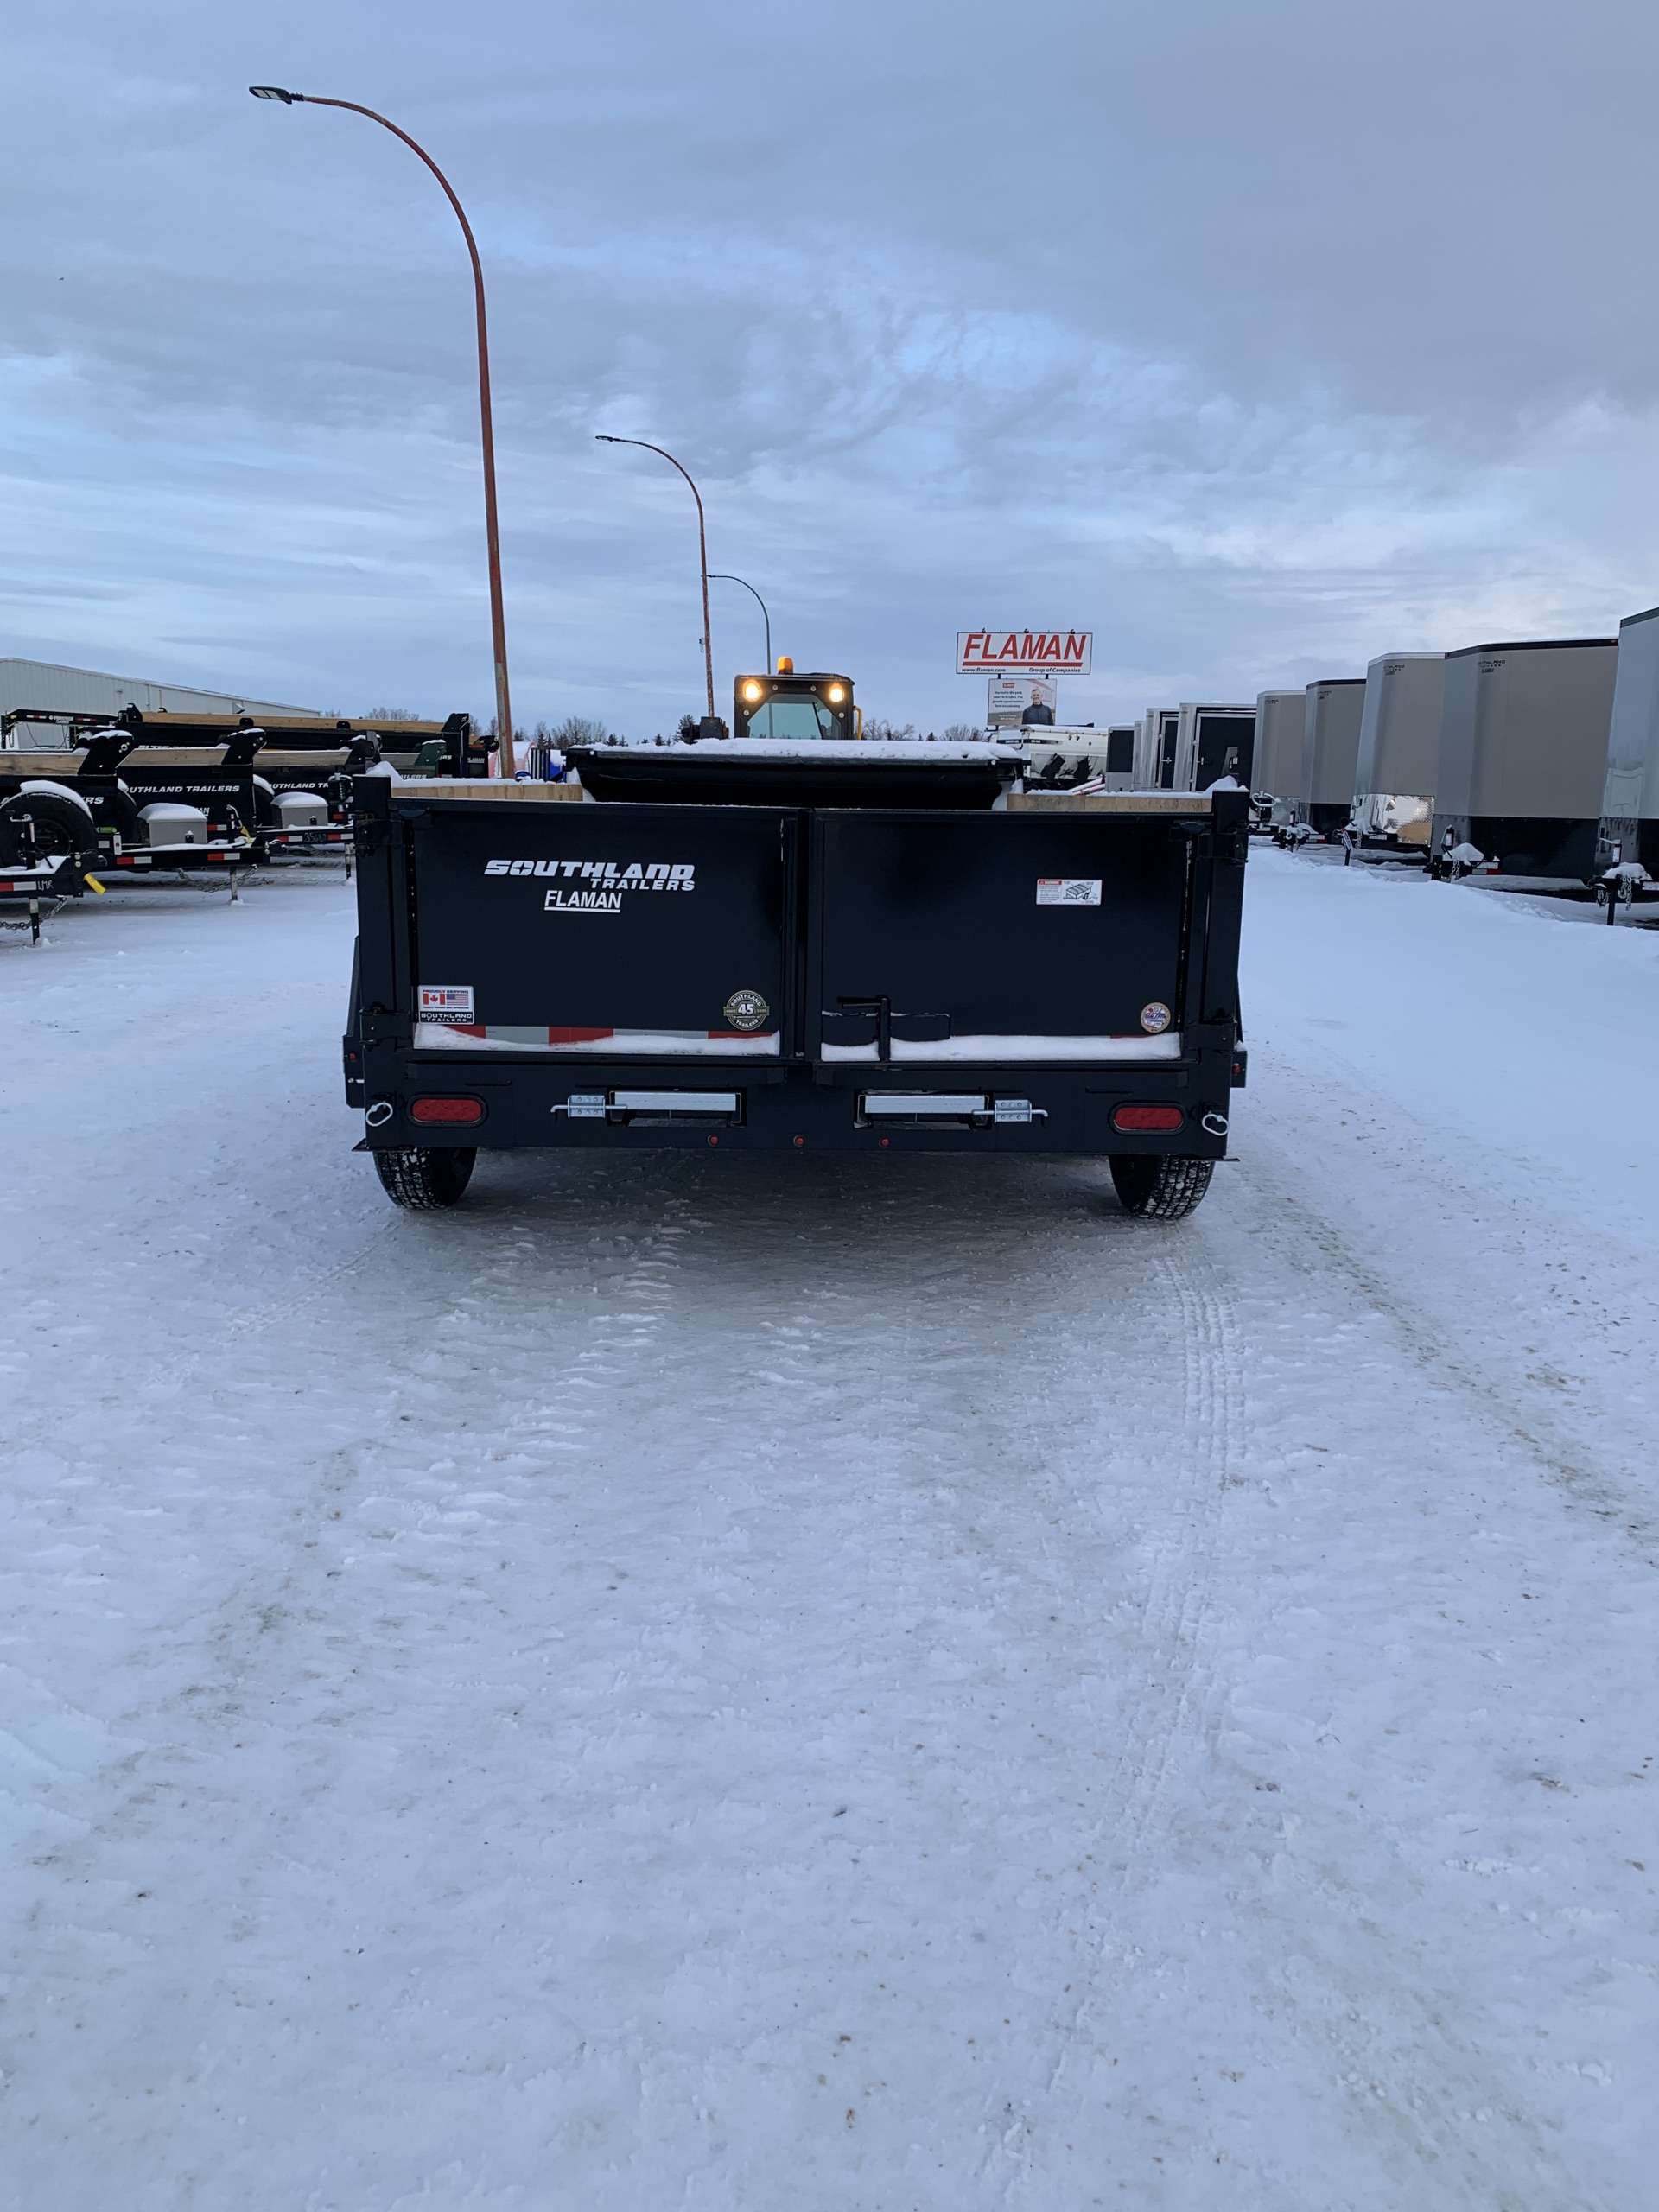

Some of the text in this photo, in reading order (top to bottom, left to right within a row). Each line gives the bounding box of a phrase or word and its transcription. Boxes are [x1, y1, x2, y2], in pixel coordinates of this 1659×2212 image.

[963, 634, 1086, 660] FLAMAN
[484, 860, 695, 880] SOUTHLAND
[590, 878, 695, 891] TRAILERS
[544, 890, 622, 908] FLAMAN
[731, 994, 761, 1007] SOUTHLAND
[738, 1003, 754, 1015] 45
